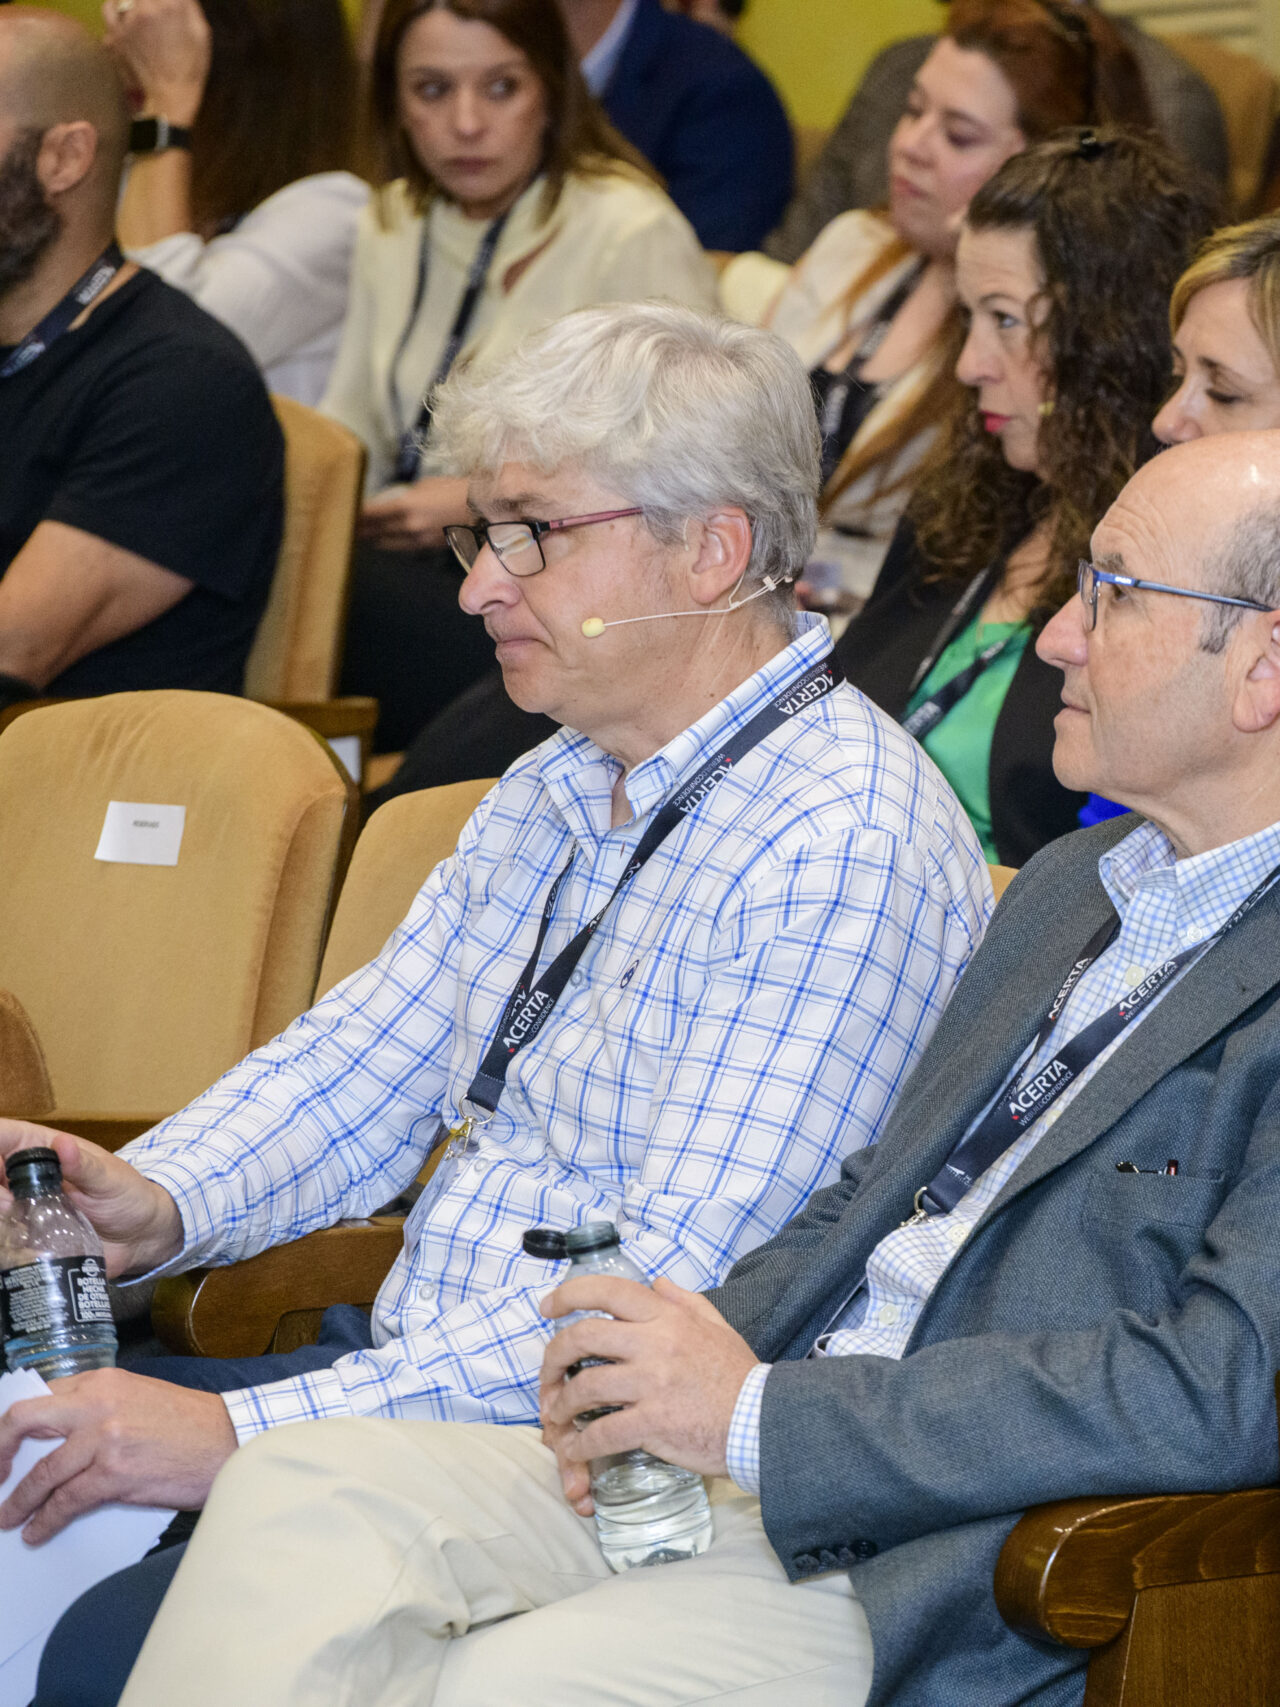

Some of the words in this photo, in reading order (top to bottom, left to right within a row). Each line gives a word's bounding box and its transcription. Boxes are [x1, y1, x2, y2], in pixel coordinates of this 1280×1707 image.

[779, 670, 834, 716] ACERTA
[1048, 957, 1089, 1021] ACERTA
[1118, 960, 1176, 1016] ACERTA
[502, 990, 549, 1053] ACERTA
[1008, 1059, 1068, 1121] ACERTA
